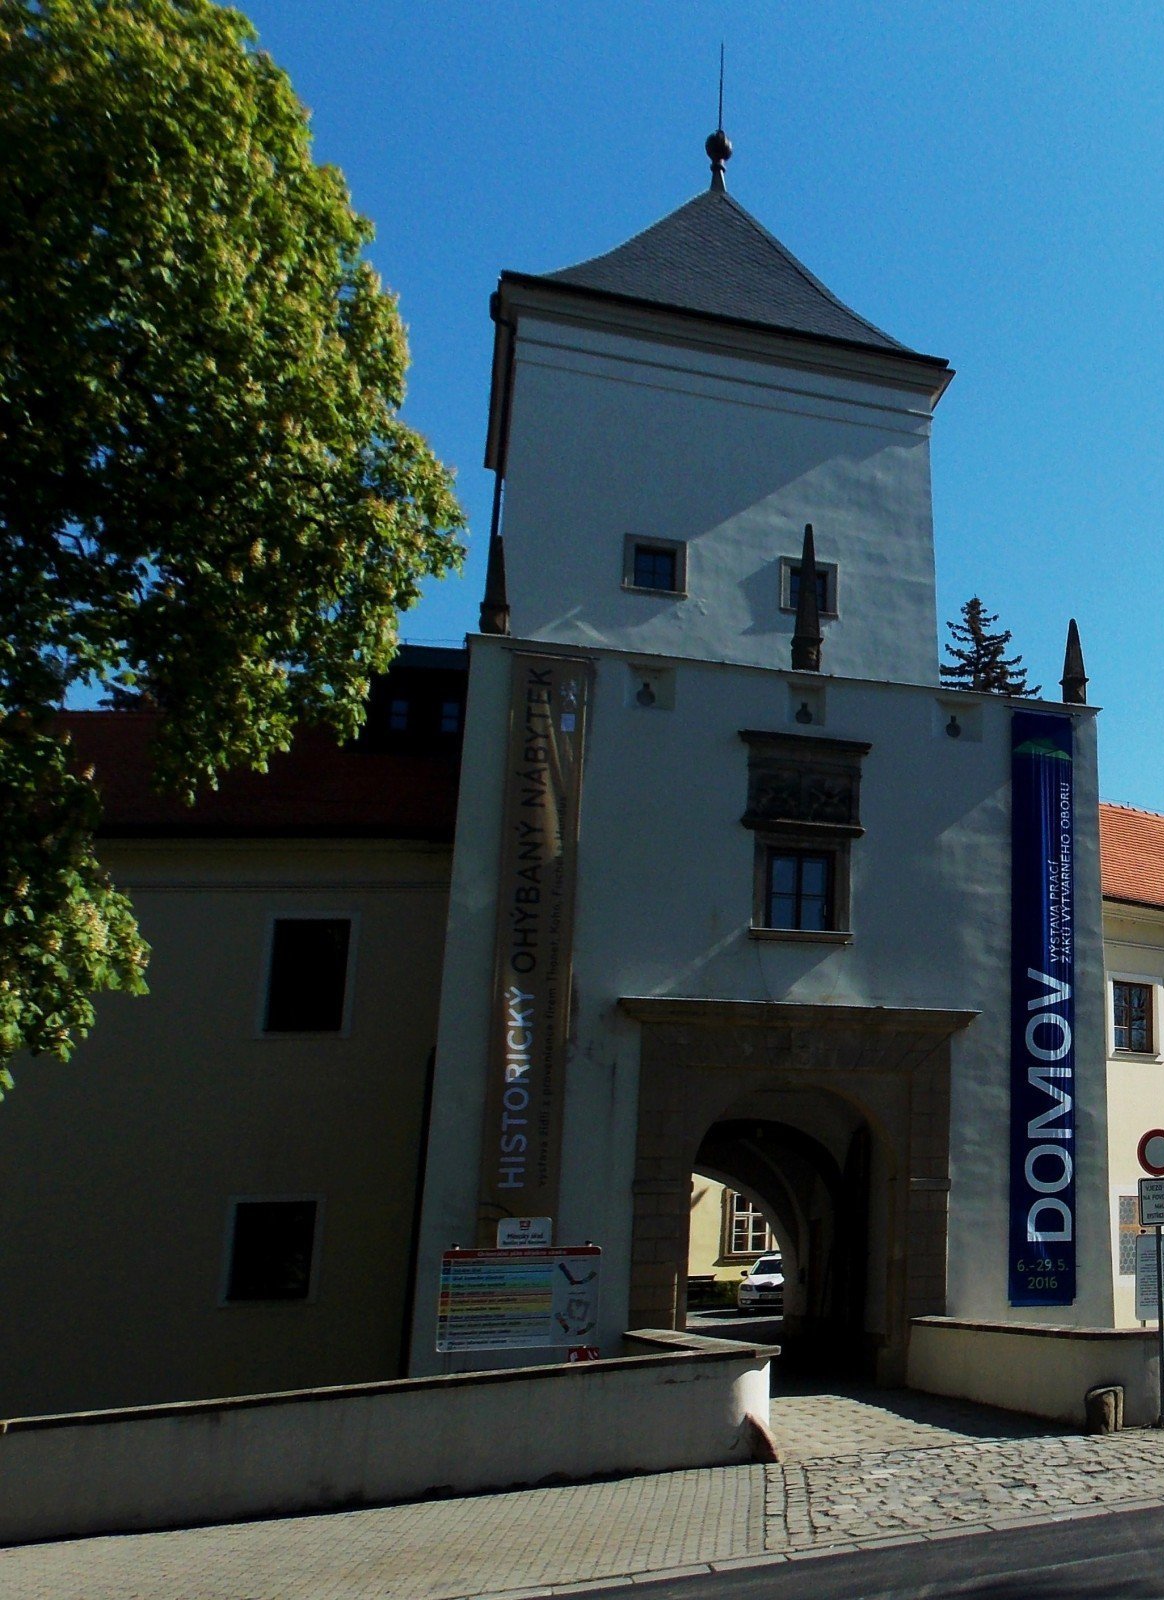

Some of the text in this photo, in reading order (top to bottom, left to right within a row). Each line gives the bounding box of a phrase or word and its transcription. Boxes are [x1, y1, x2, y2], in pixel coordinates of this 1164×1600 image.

[497, 668, 553, 1189] HISTORICKÝ OHÝBANÝ NÁBYTEK
[1047, 859, 1060, 963] VÝSTAVA PRACÍ
[1059, 782, 1072, 964] ŽÁKŮ VÝTVARNÉHO OBORU
[1024, 967, 1073, 1242] DOMOV
[1027, 1277, 1058, 1289] 2016
